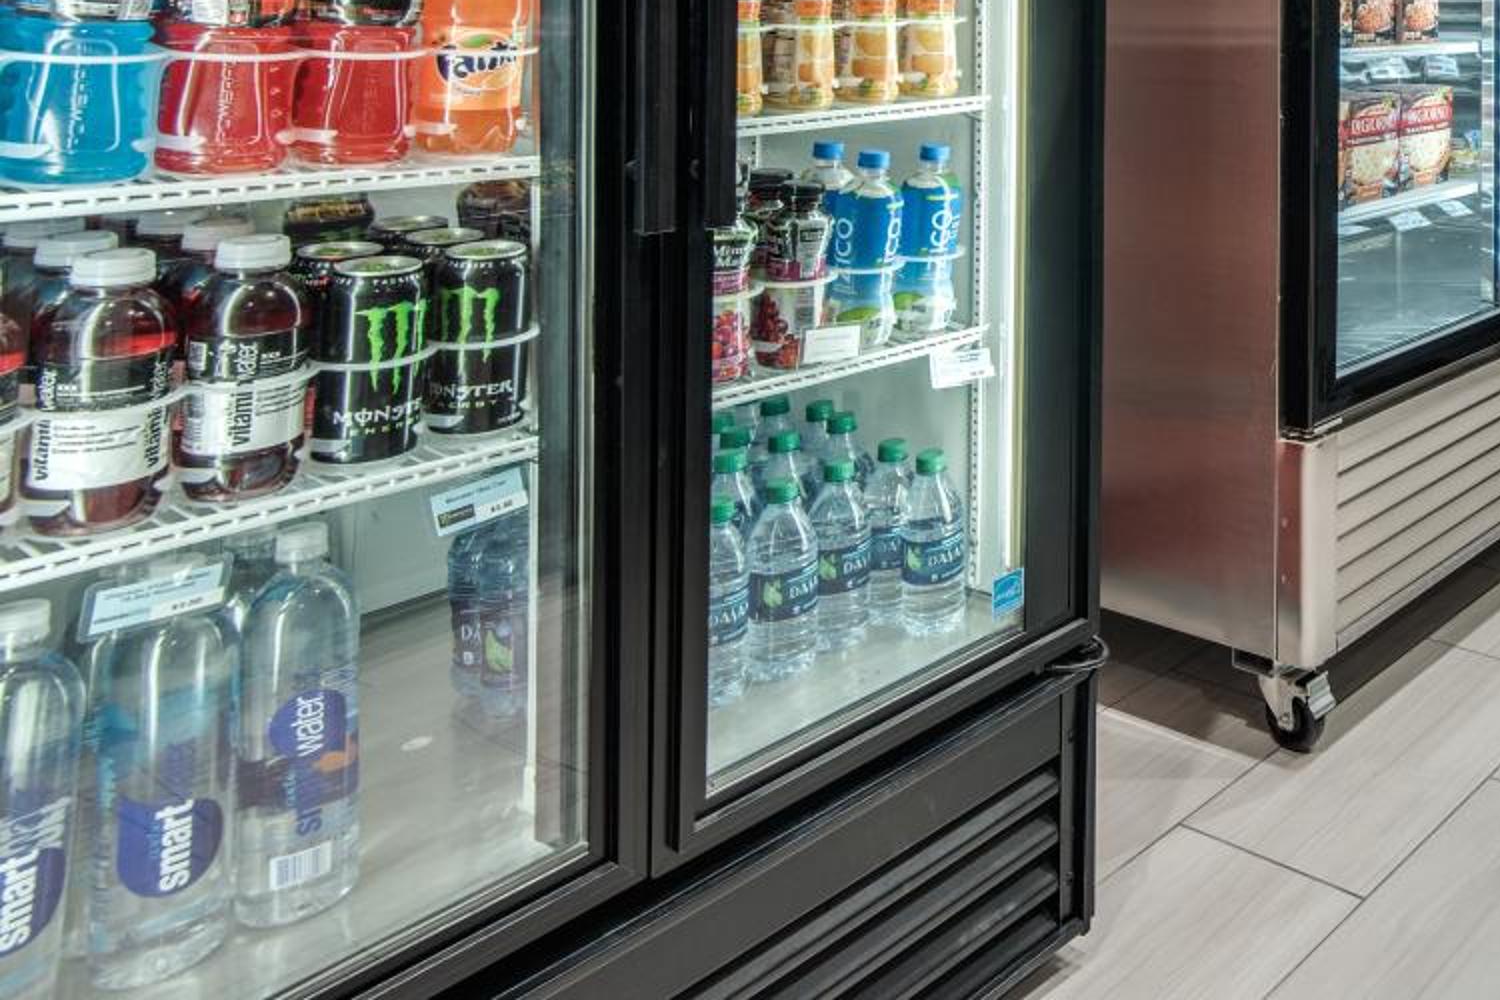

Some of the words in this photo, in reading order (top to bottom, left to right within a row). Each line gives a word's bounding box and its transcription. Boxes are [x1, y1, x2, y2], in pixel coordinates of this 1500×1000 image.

[332, 396, 422, 427] MONST
[429, 379, 514, 402] ONSTER
[290, 691, 326, 758] water
[154, 799, 195, 892] smart
[0, 848, 40, 952] smart
